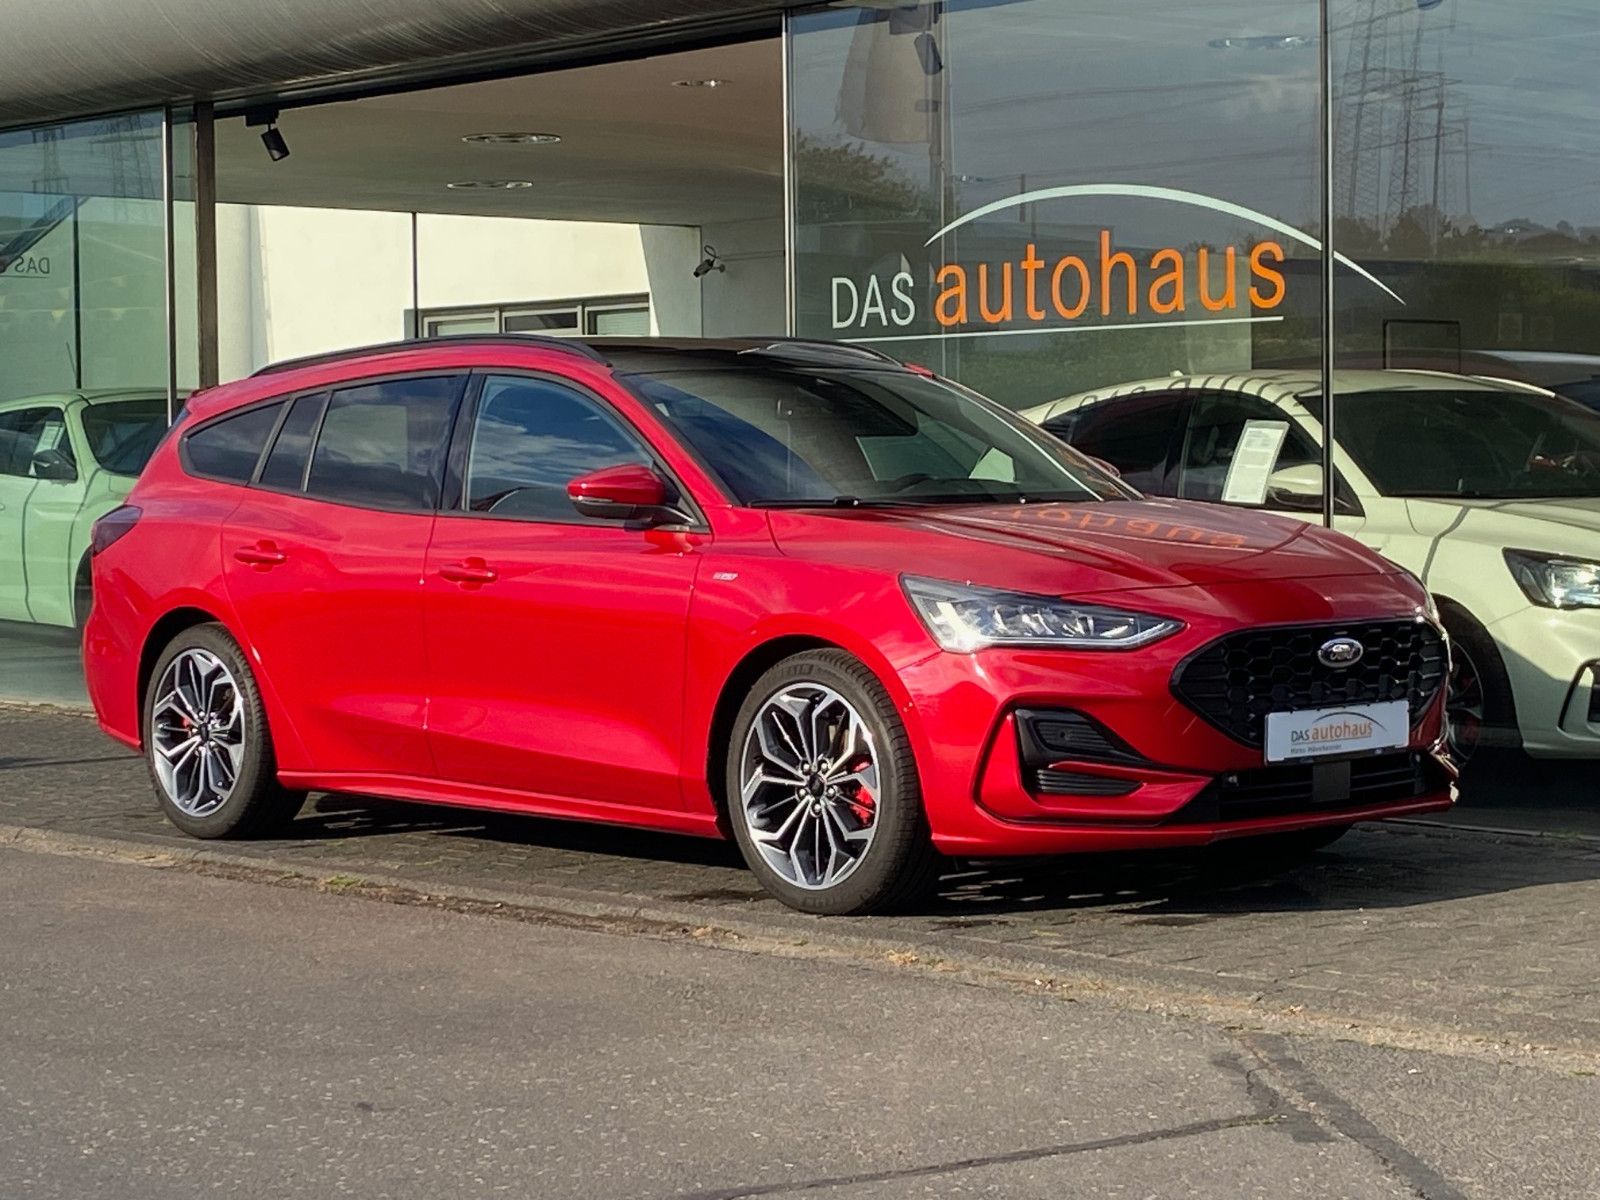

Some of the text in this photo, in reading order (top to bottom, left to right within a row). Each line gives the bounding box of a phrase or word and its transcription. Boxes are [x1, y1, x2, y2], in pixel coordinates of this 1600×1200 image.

[831, 230, 1286, 329] DAS autohaus
[1290, 720, 1373, 743] DAS autohaus
